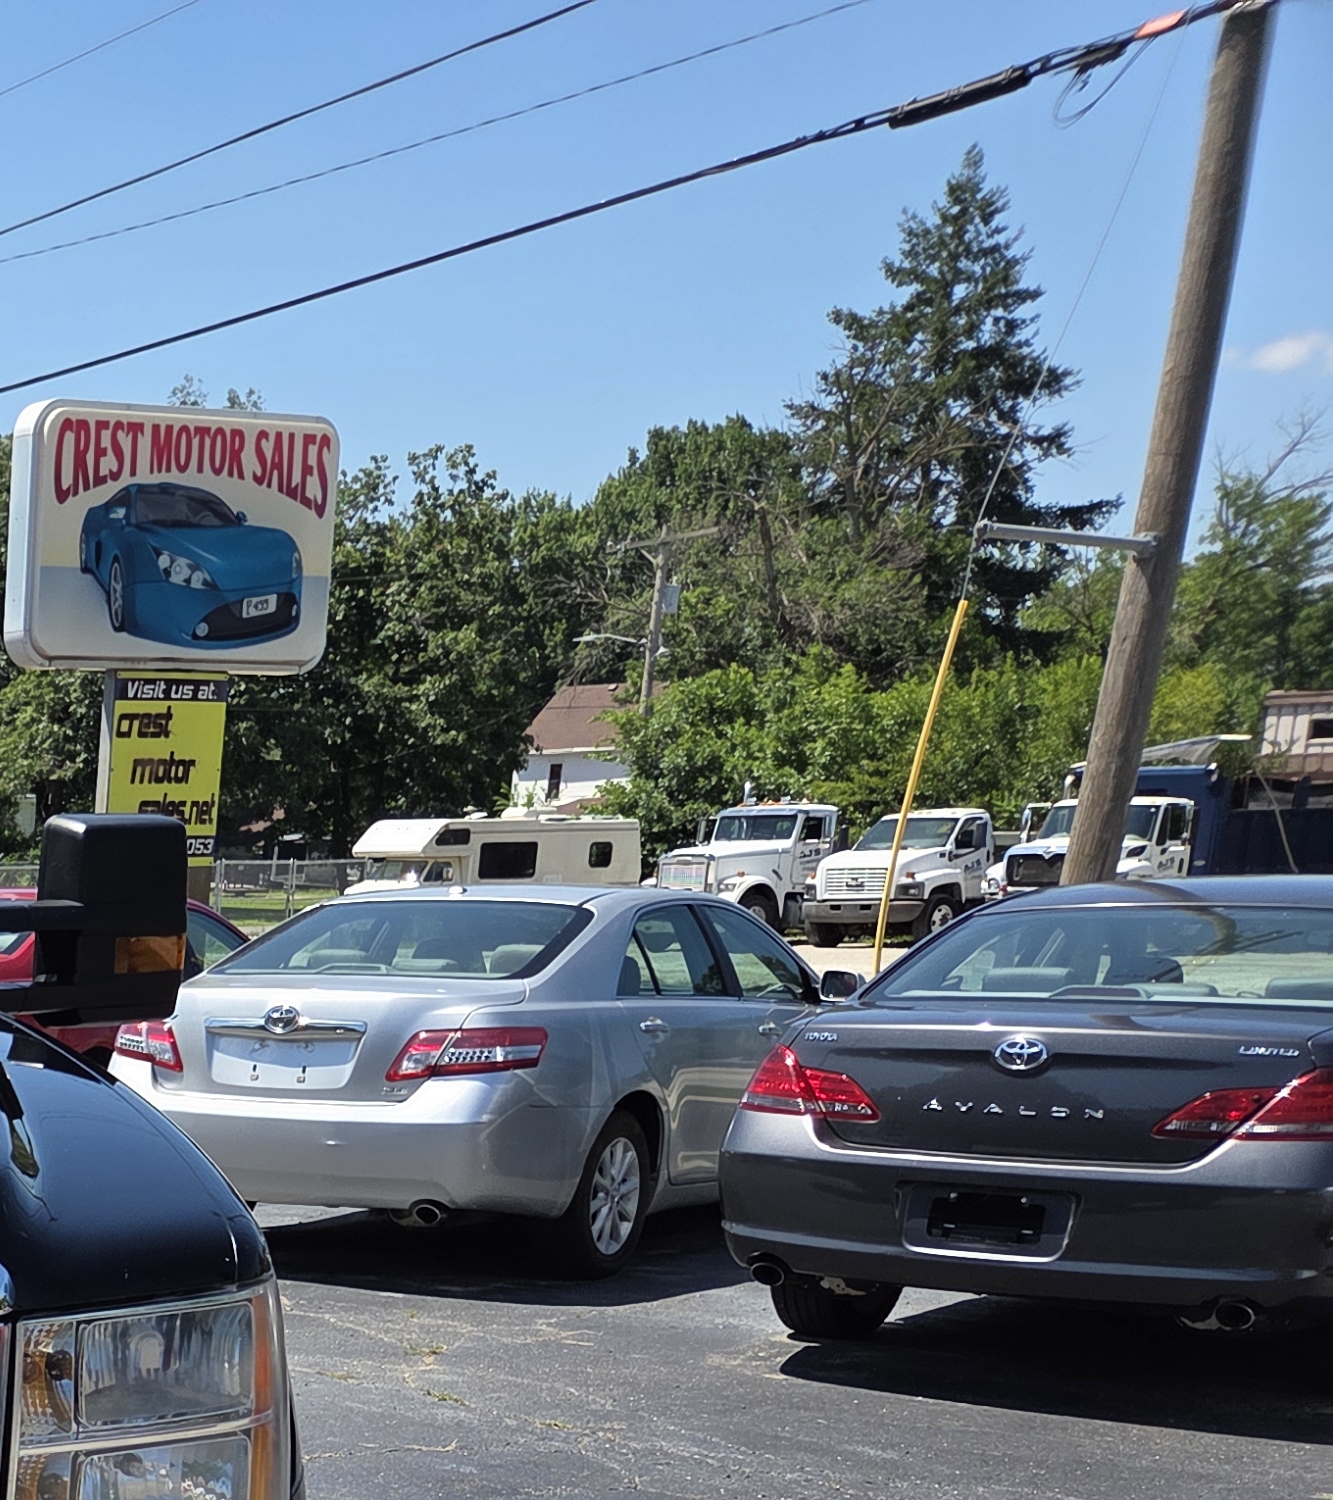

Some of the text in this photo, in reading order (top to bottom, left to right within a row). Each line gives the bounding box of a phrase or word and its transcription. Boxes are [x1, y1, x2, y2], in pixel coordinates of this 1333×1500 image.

[54, 417, 331, 519] CREST MOTOR SALES
[127, 680, 166, 699] Visit
[170, 684, 195, 699] us
[115, 705, 174, 739] crest
[129, 750, 197, 785] motor
[804, 1031, 838, 1041] TOYOTA
[921, 1097, 1105, 1119] AVALON
